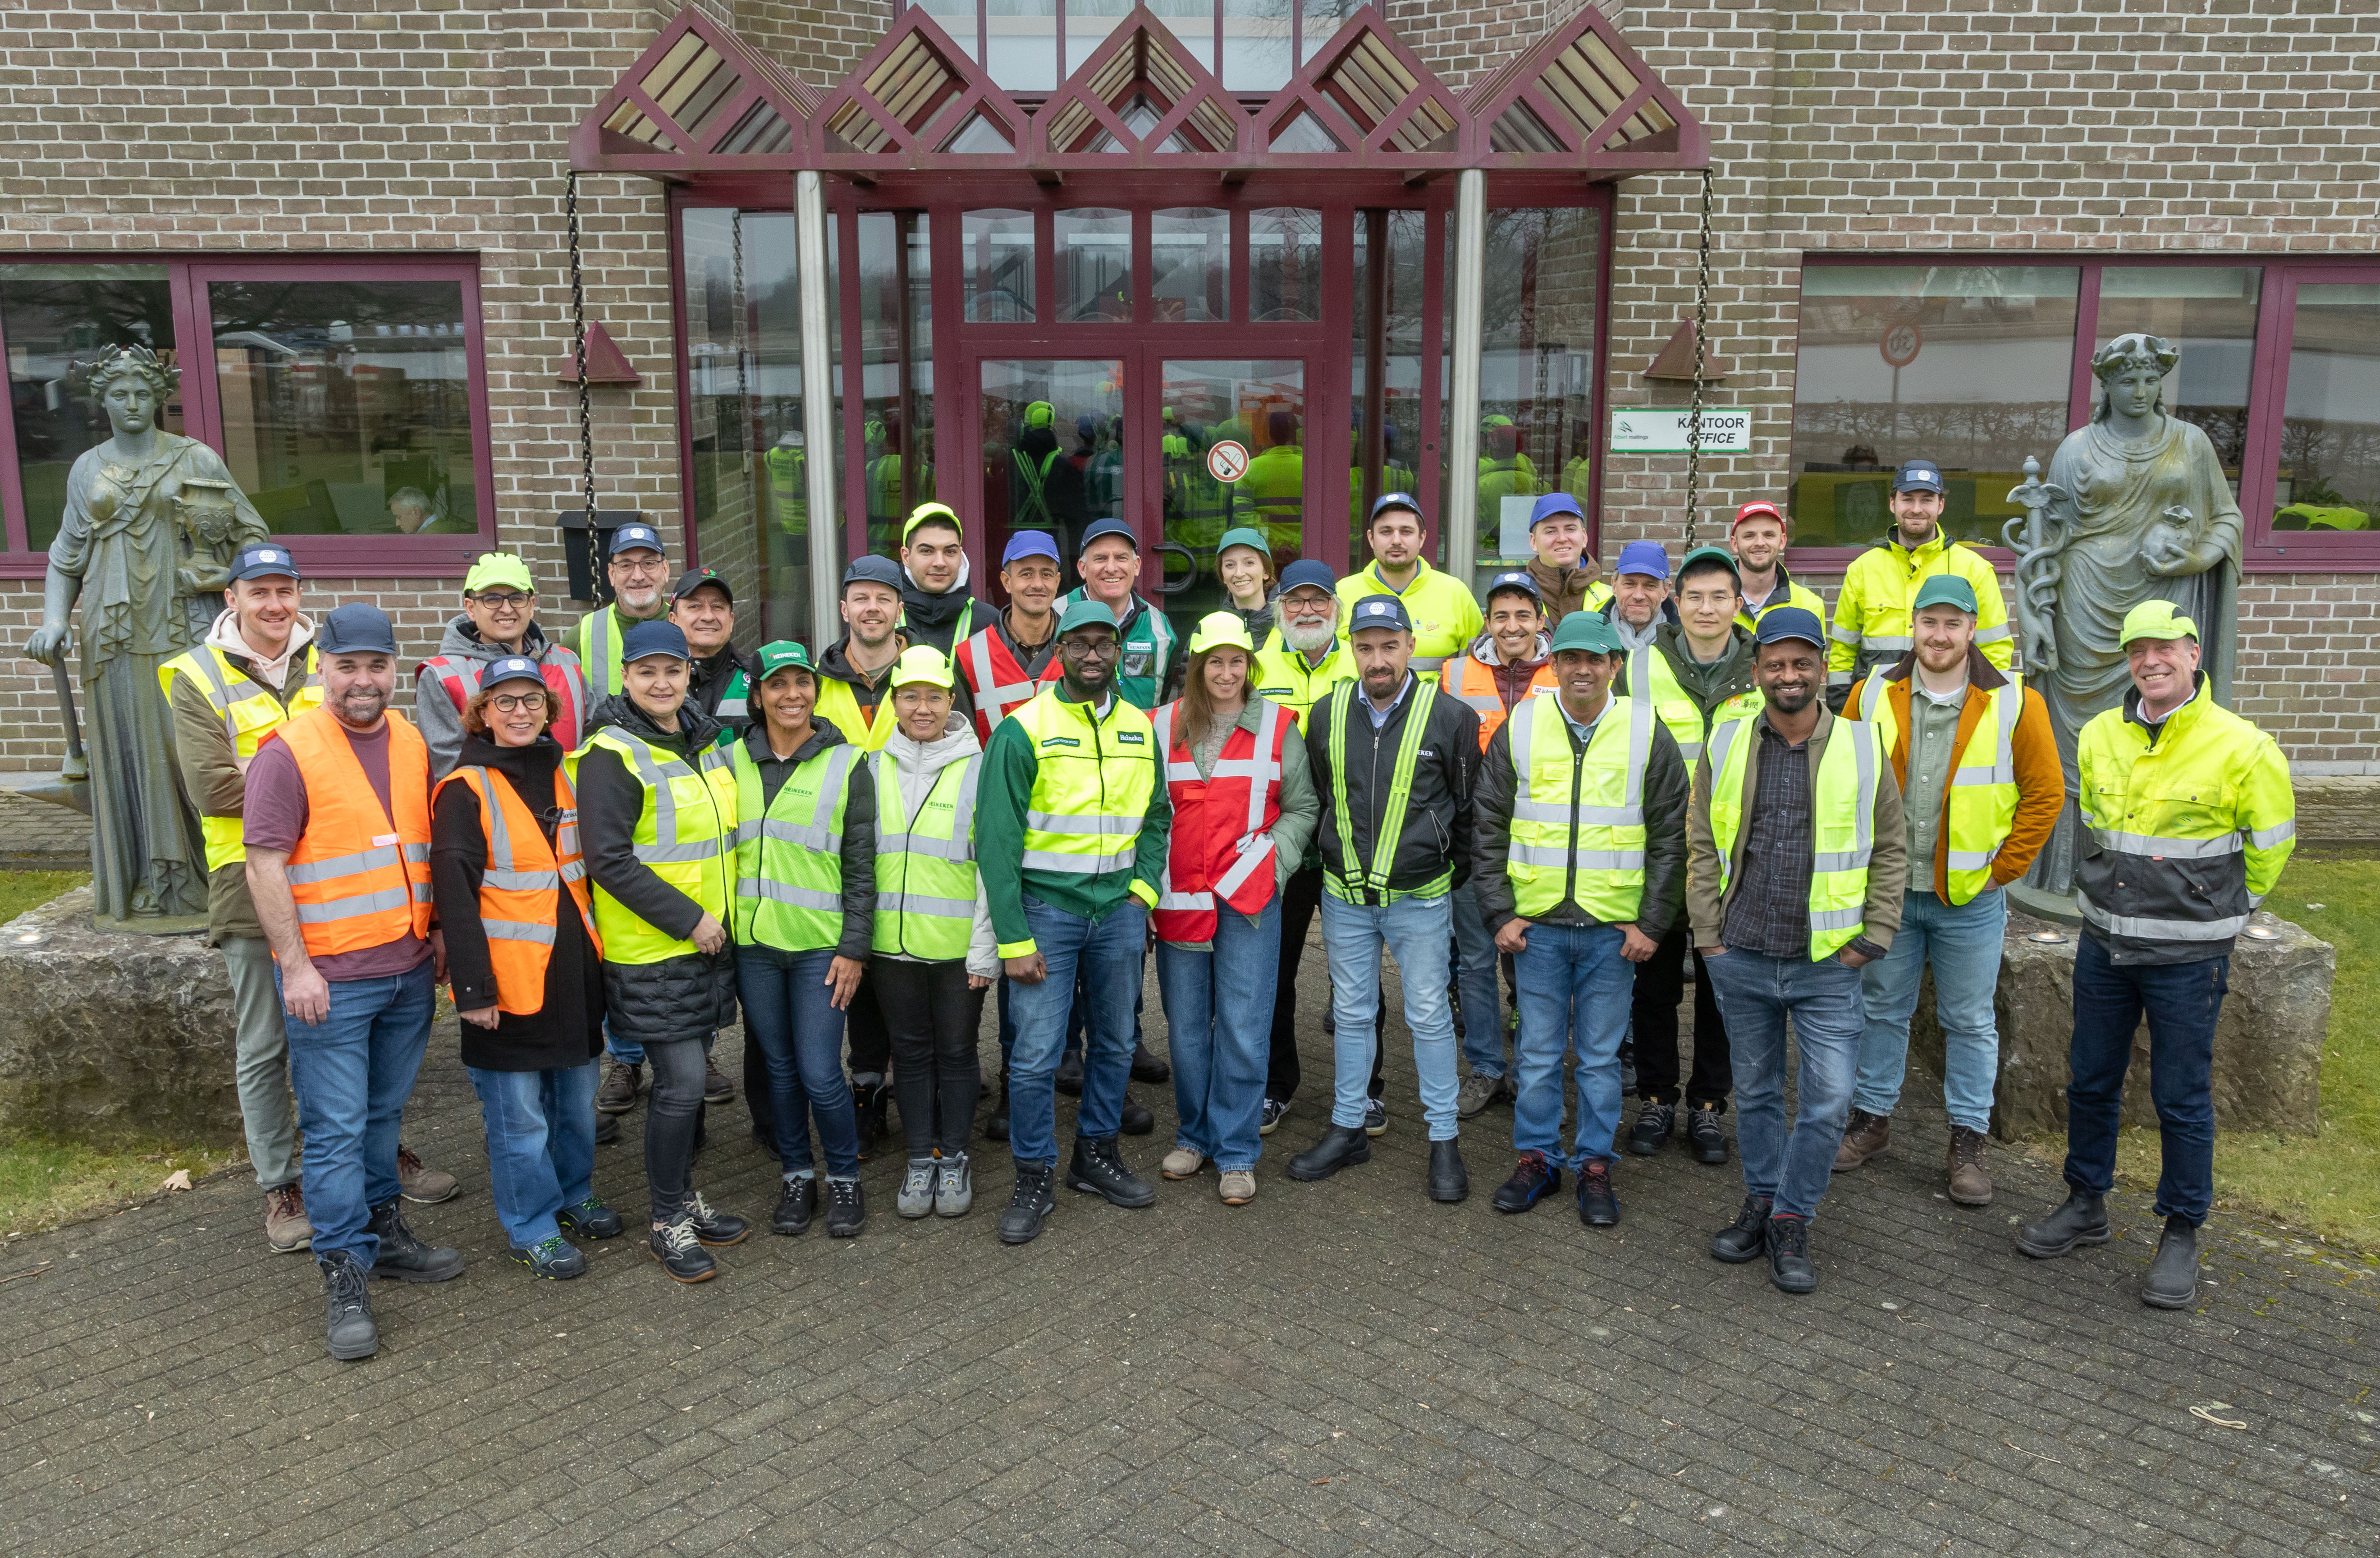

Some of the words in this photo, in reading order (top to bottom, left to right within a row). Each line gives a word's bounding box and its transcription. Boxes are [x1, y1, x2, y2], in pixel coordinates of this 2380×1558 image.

[1678, 418, 1744, 428] KANTOOR
[773, 652, 801, 660] HEINEKEN
[784, 786, 813, 795] HEINEKEN
